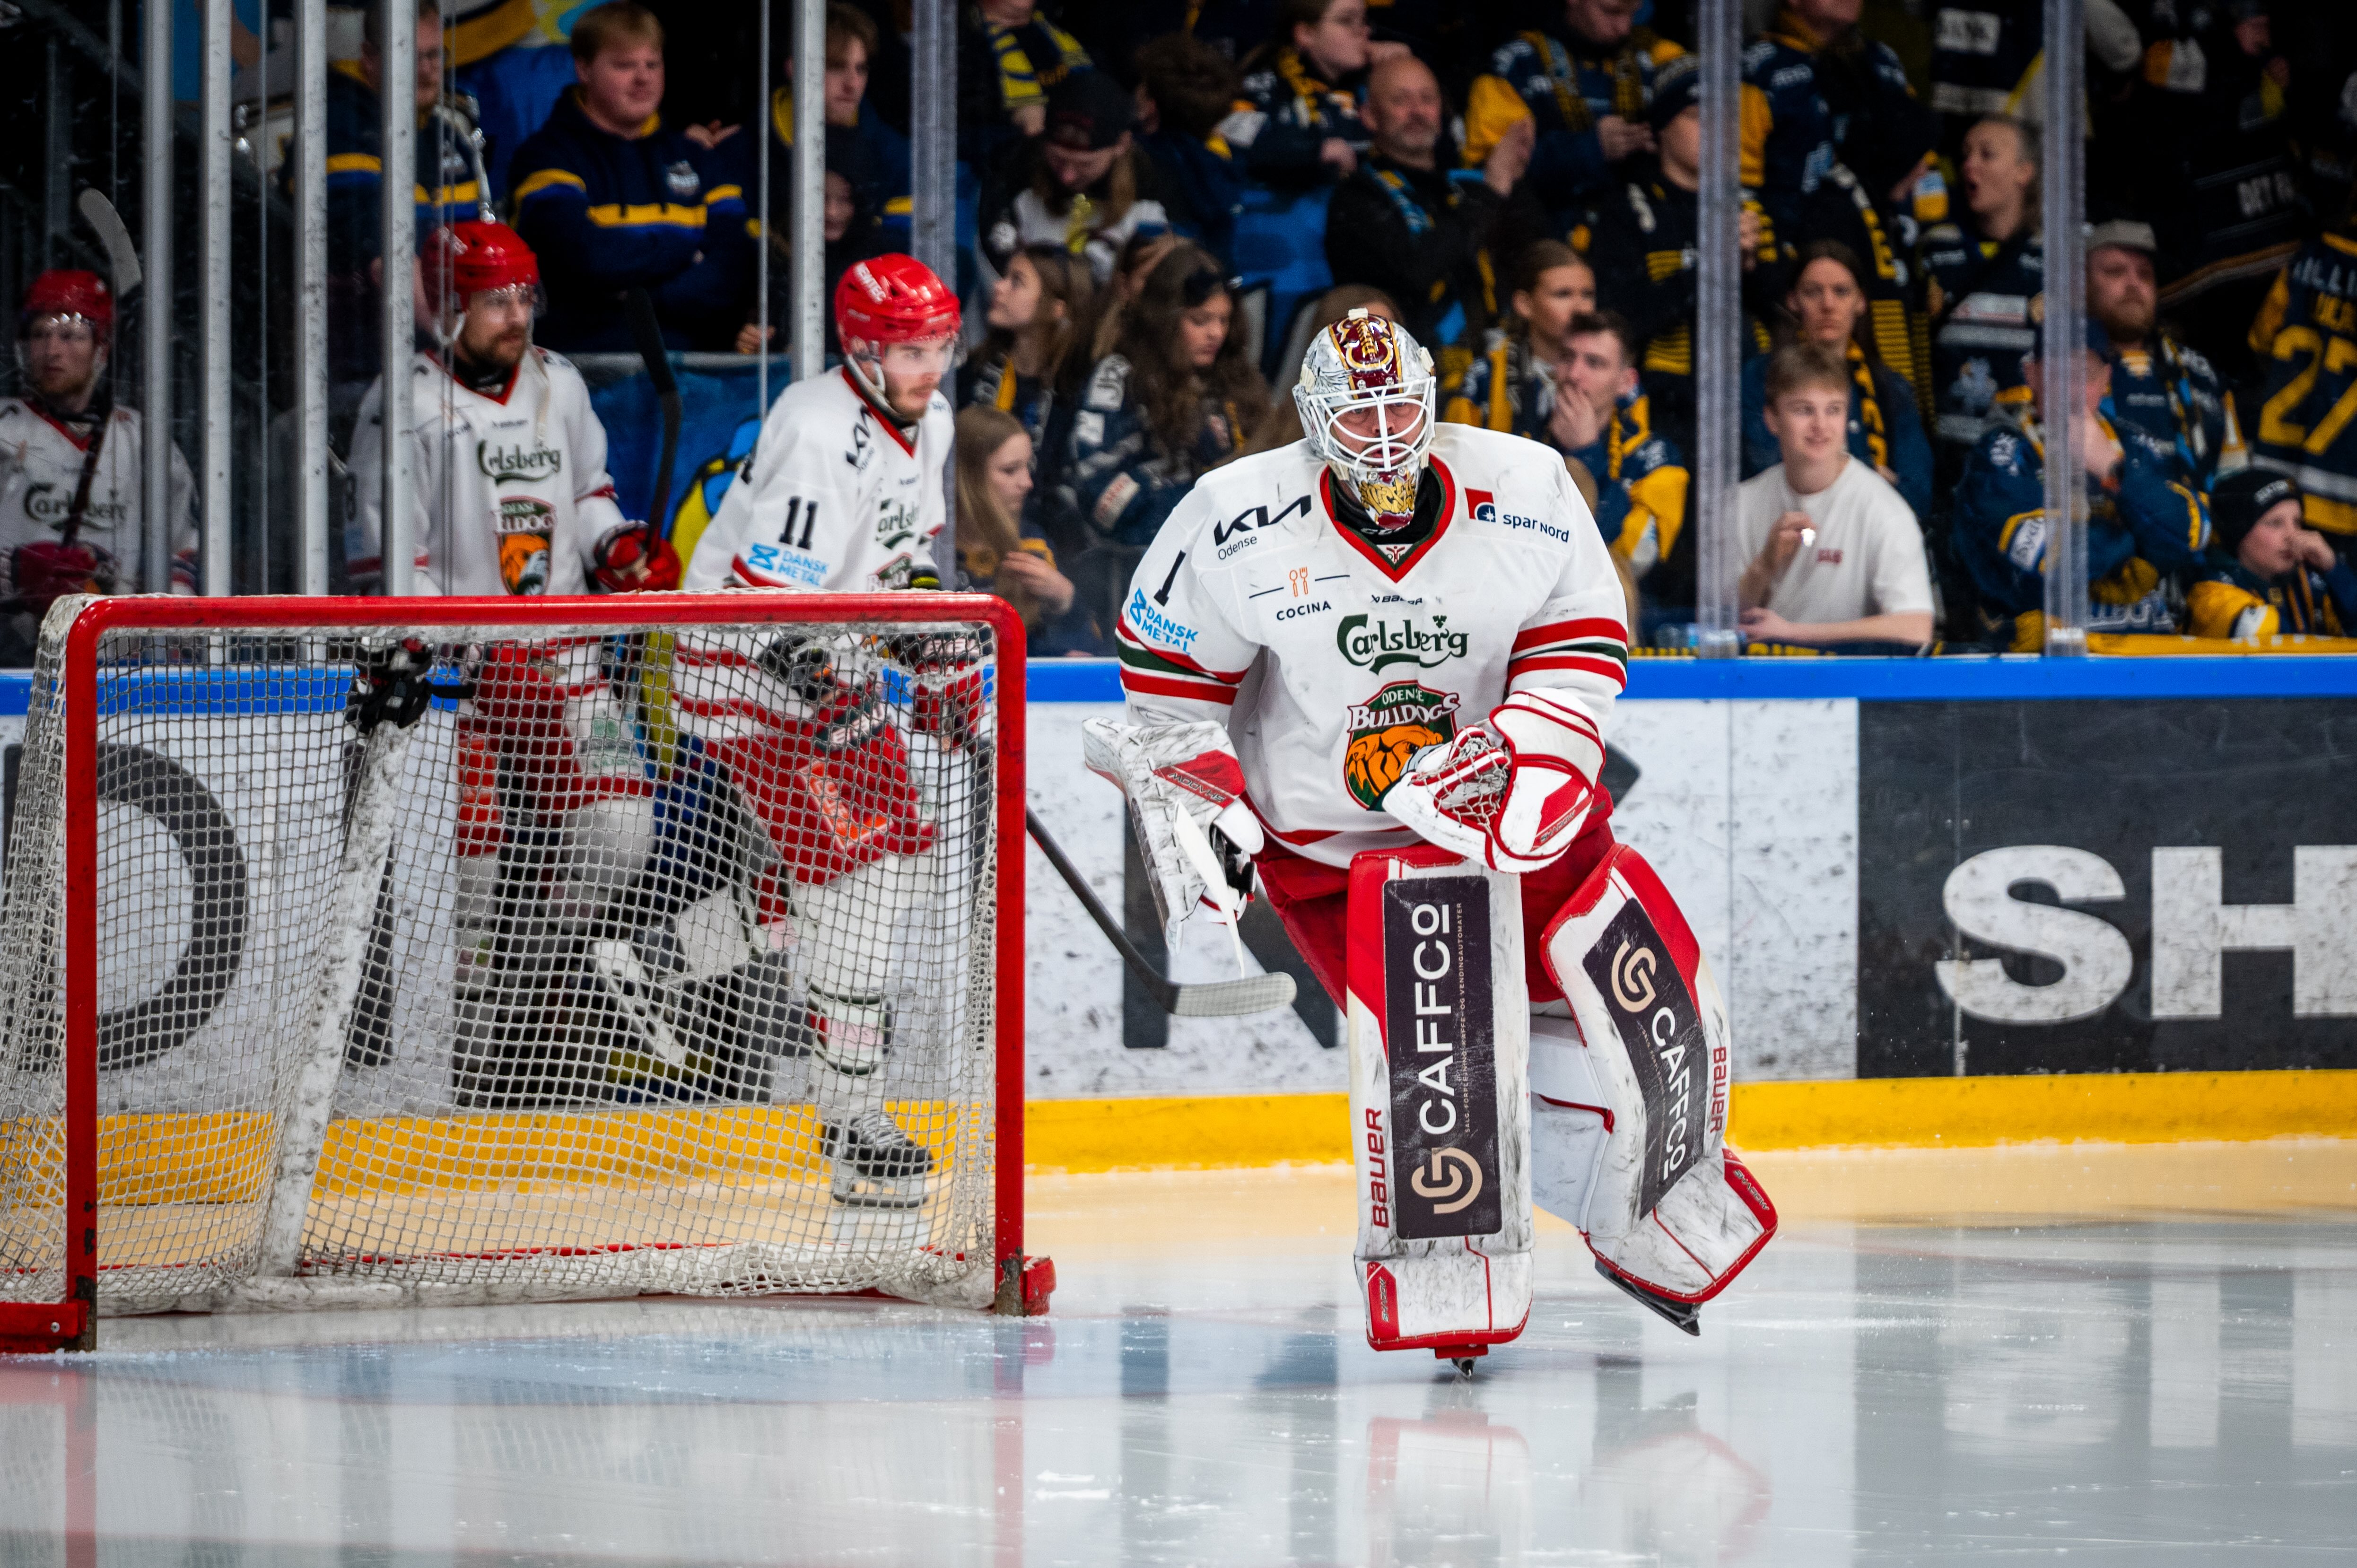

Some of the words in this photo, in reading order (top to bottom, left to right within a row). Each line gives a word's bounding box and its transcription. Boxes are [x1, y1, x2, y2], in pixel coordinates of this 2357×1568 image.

[778, 496, 818, 550] 11
[1213, 494, 1312, 546] KIA
[1503, 514, 1538, 530] spar
[1218, 535, 1257, 560] Odense
[1153, 549, 1187, 607] 1
[1145, 605, 1199, 643] DANSK
[1276, 600, 1332, 621] COCINA
[1141, 622, 1192, 656] METAL
[1337, 613, 1469, 674] Carlsberg
[1382, 688, 1424, 706] ODENSE
[1167, 772, 1226, 802] SHADOW
[1457, 902, 1465, 995] VENDINGAUTOMATER
[1411, 903, 1458, 1135] CAFFCO
[1460, 998, 1466, 1010] OG
[1652, 1006, 1690, 1181] CAFFCO
